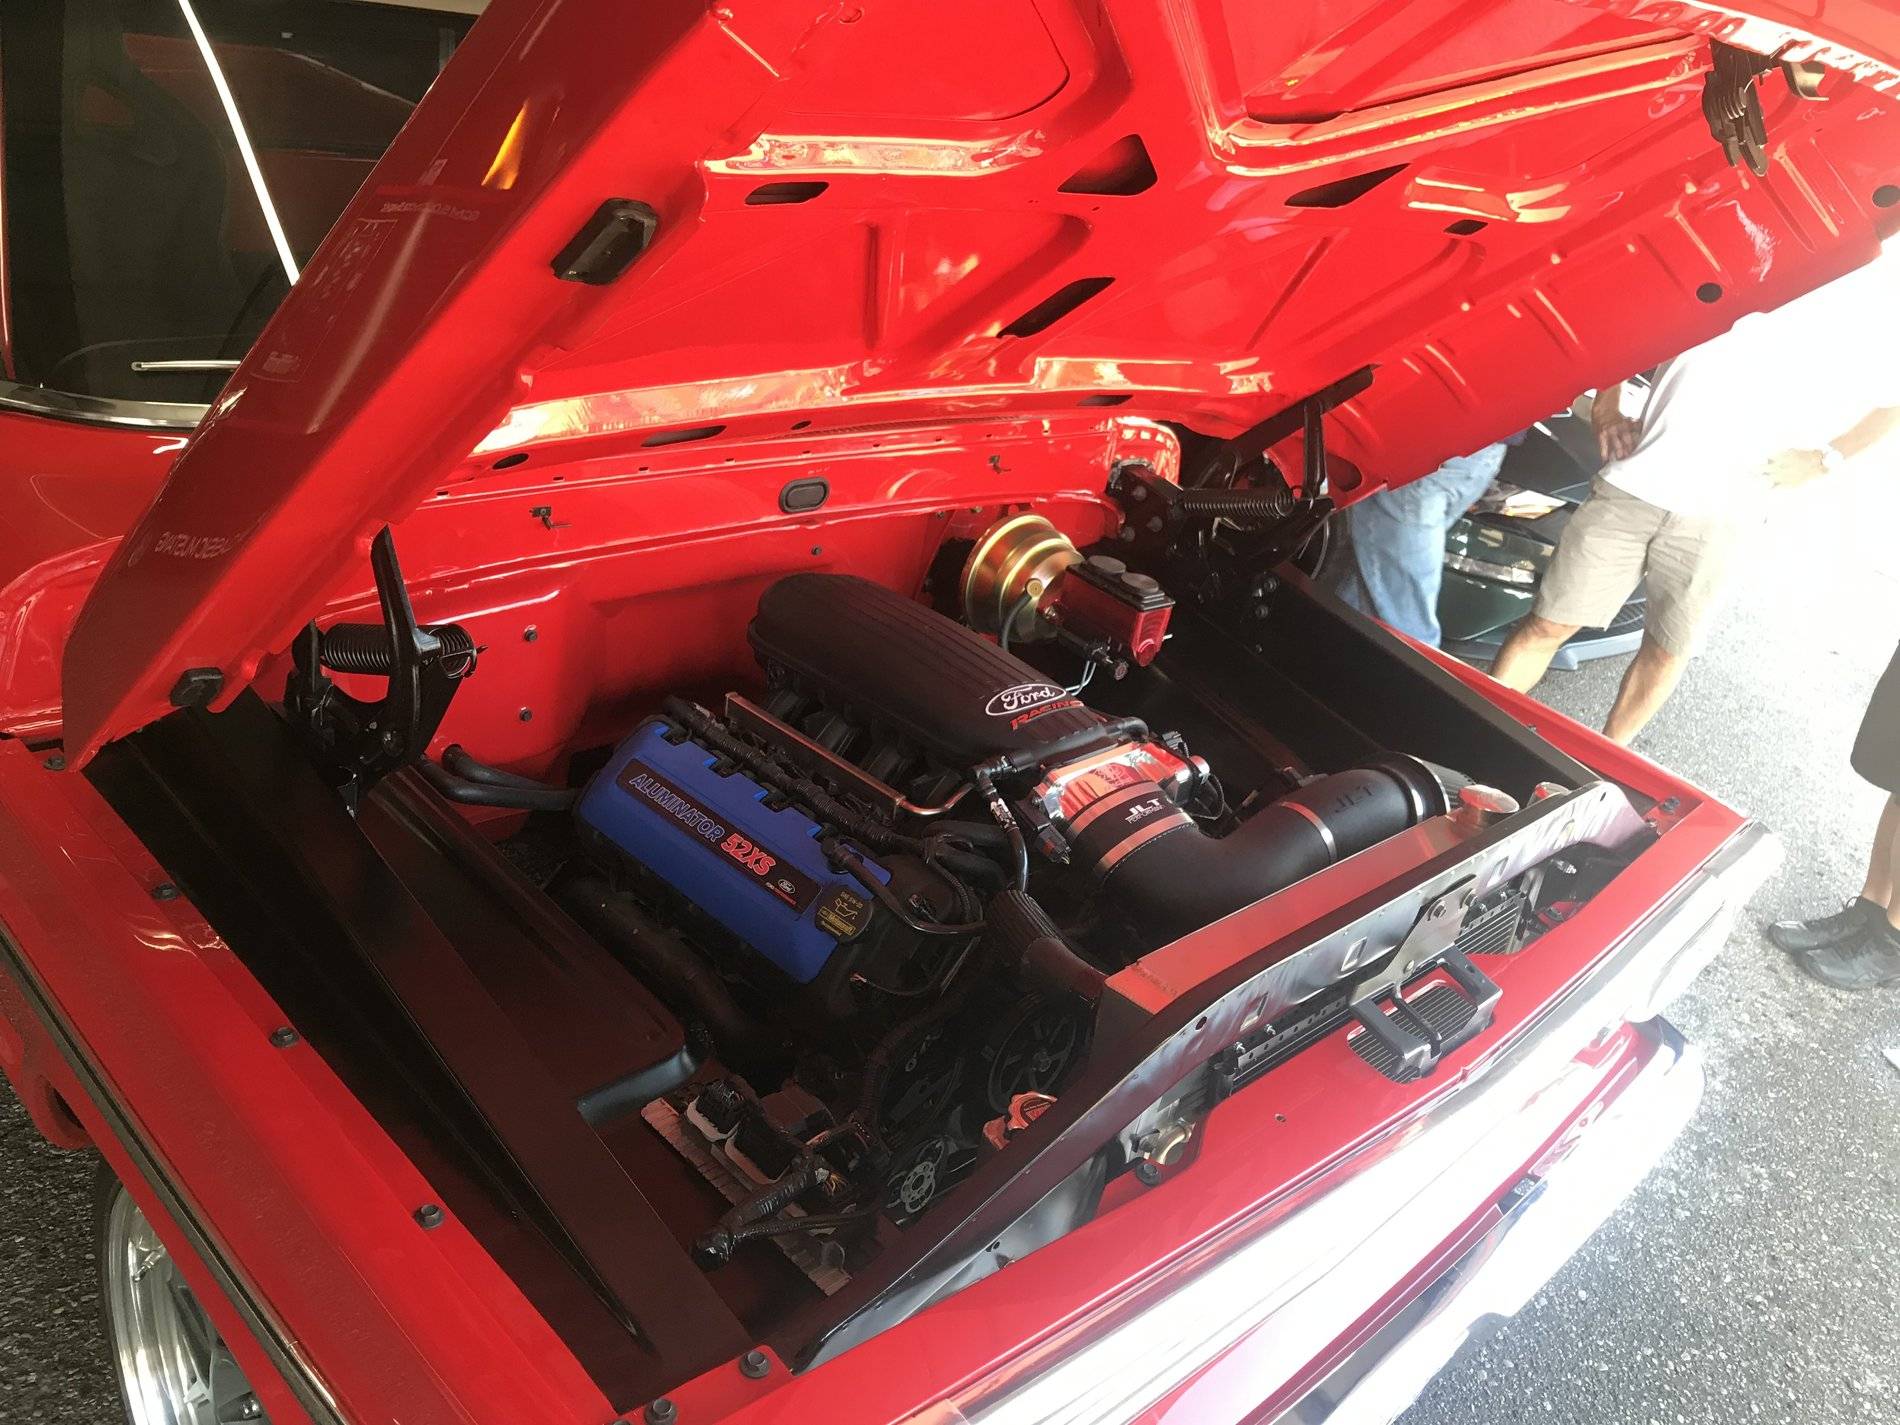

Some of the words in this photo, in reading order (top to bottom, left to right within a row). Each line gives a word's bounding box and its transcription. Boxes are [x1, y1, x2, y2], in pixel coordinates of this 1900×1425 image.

[1001, 686, 1056, 710] Ford
[1125, 798, 1161, 819] JLT
[628, 773, 726, 843] ALUMINATOR
[720, 832, 777, 876] 52XS
